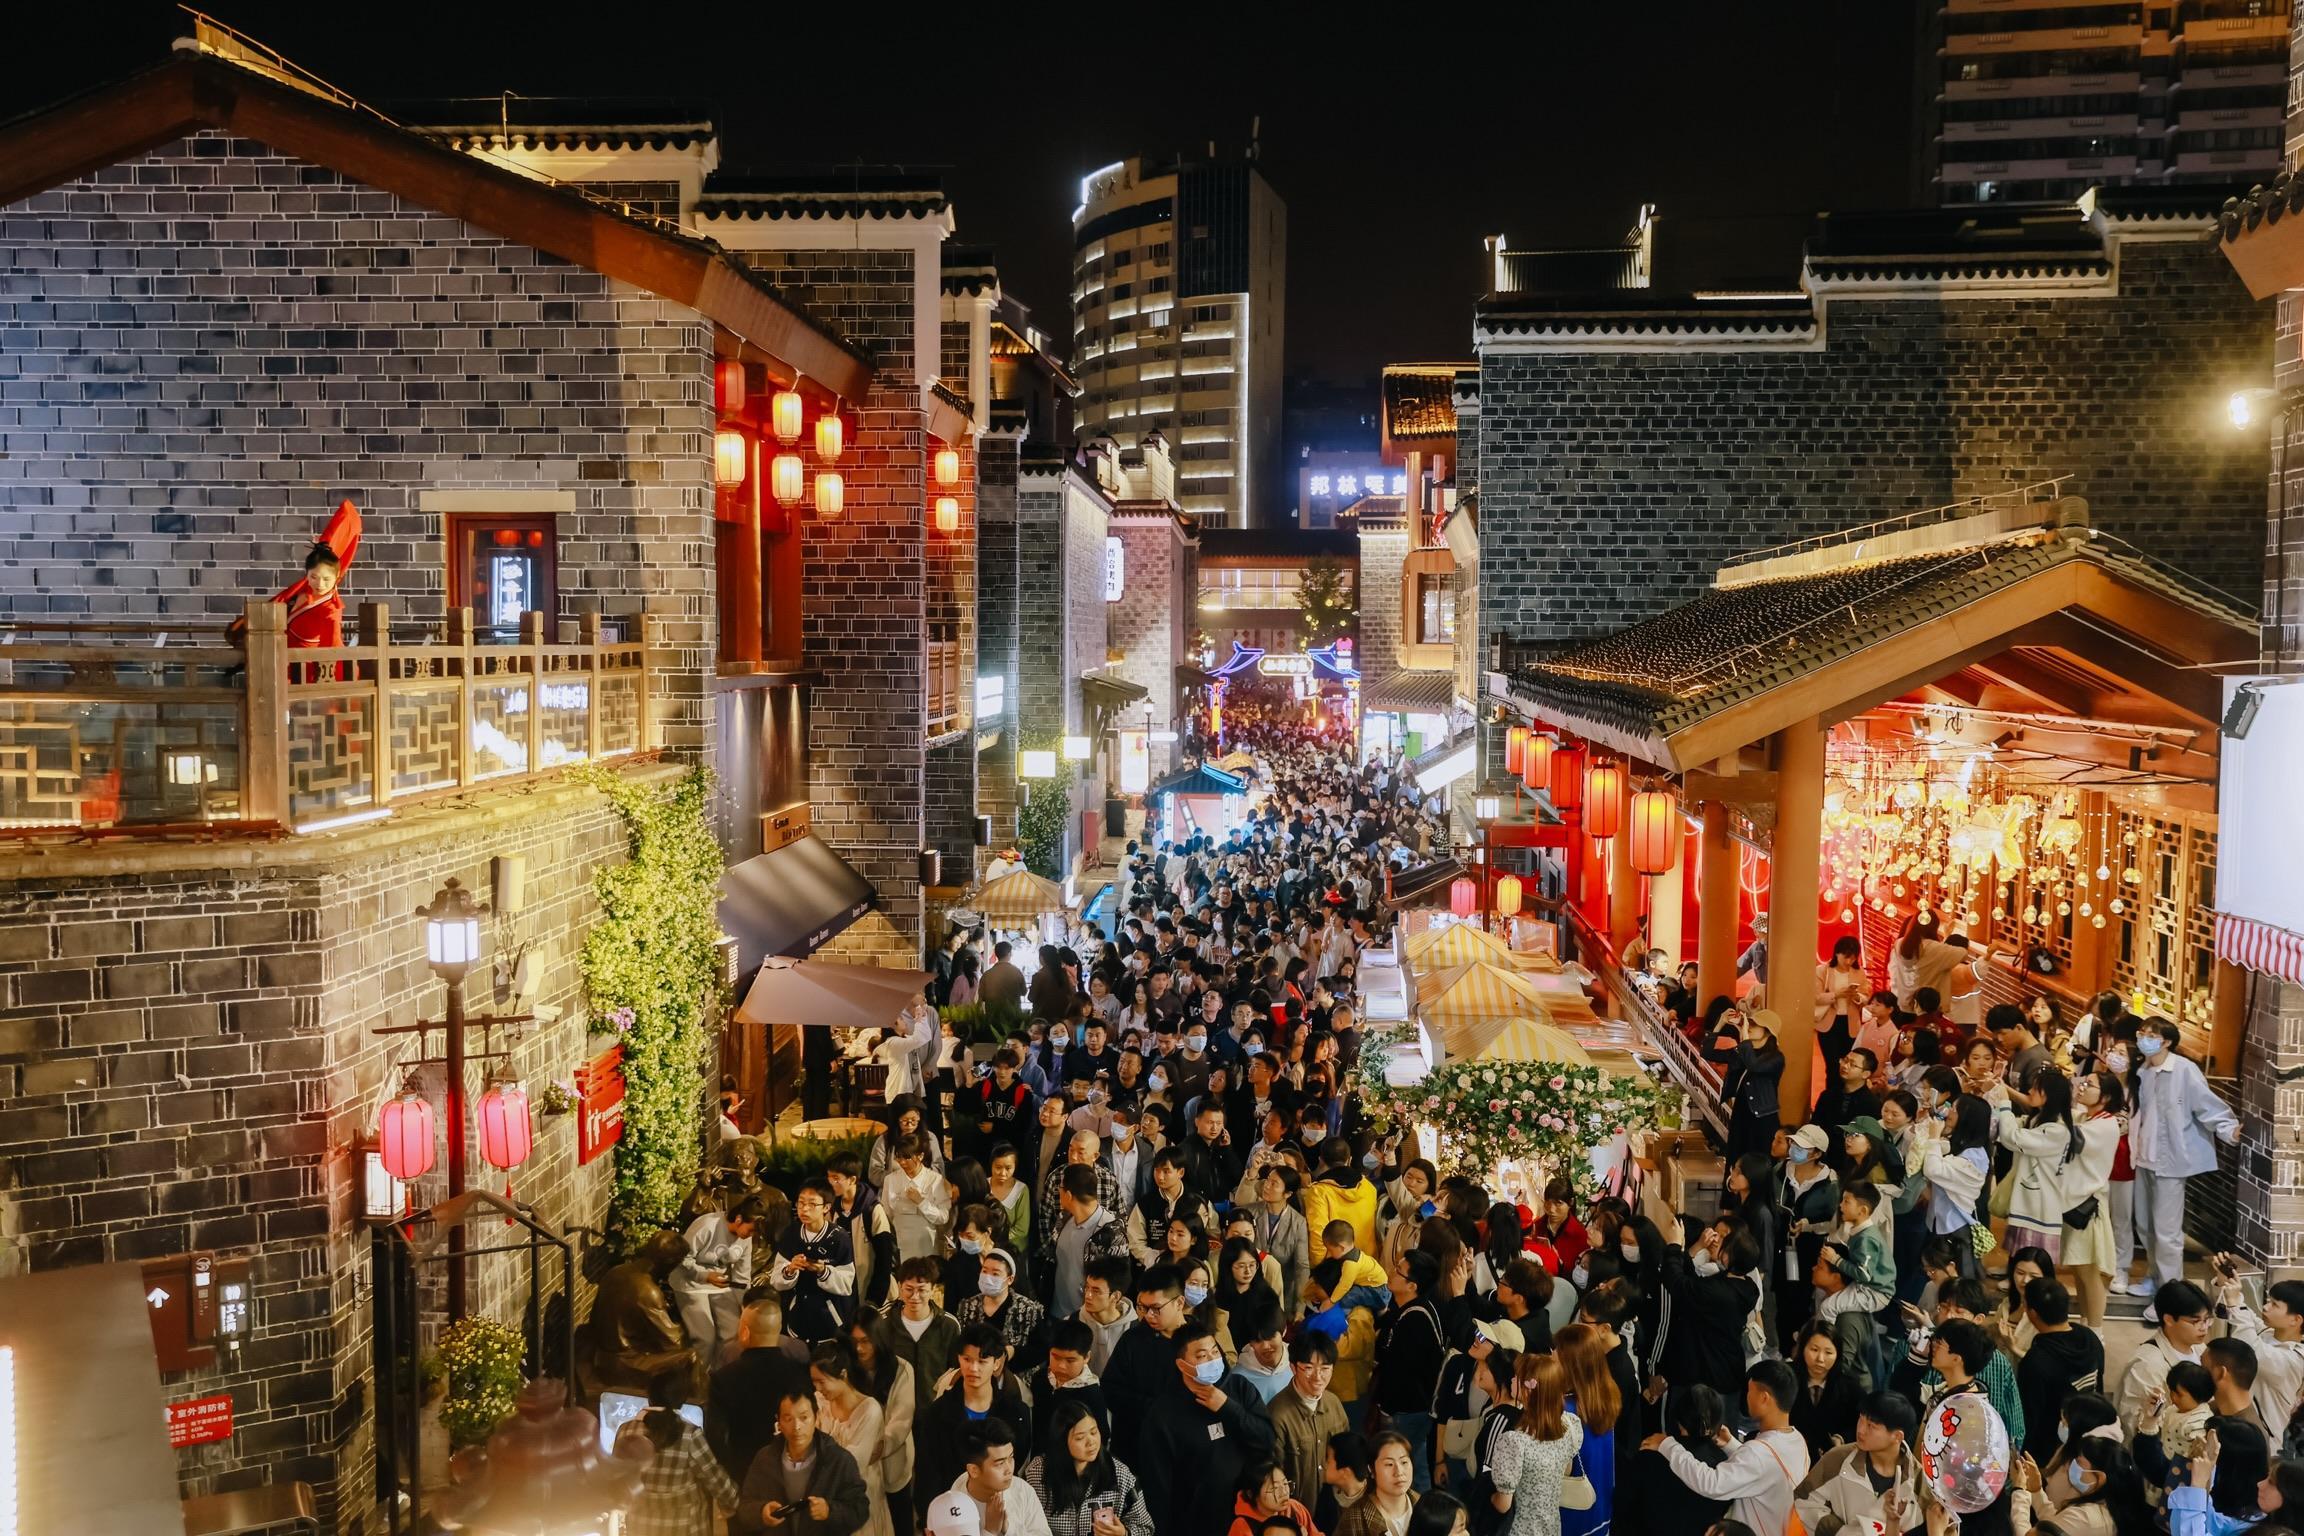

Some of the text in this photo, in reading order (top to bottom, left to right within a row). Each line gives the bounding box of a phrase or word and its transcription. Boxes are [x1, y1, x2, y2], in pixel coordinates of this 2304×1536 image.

[177, 1401, 228, 1419] 室外消防栓
